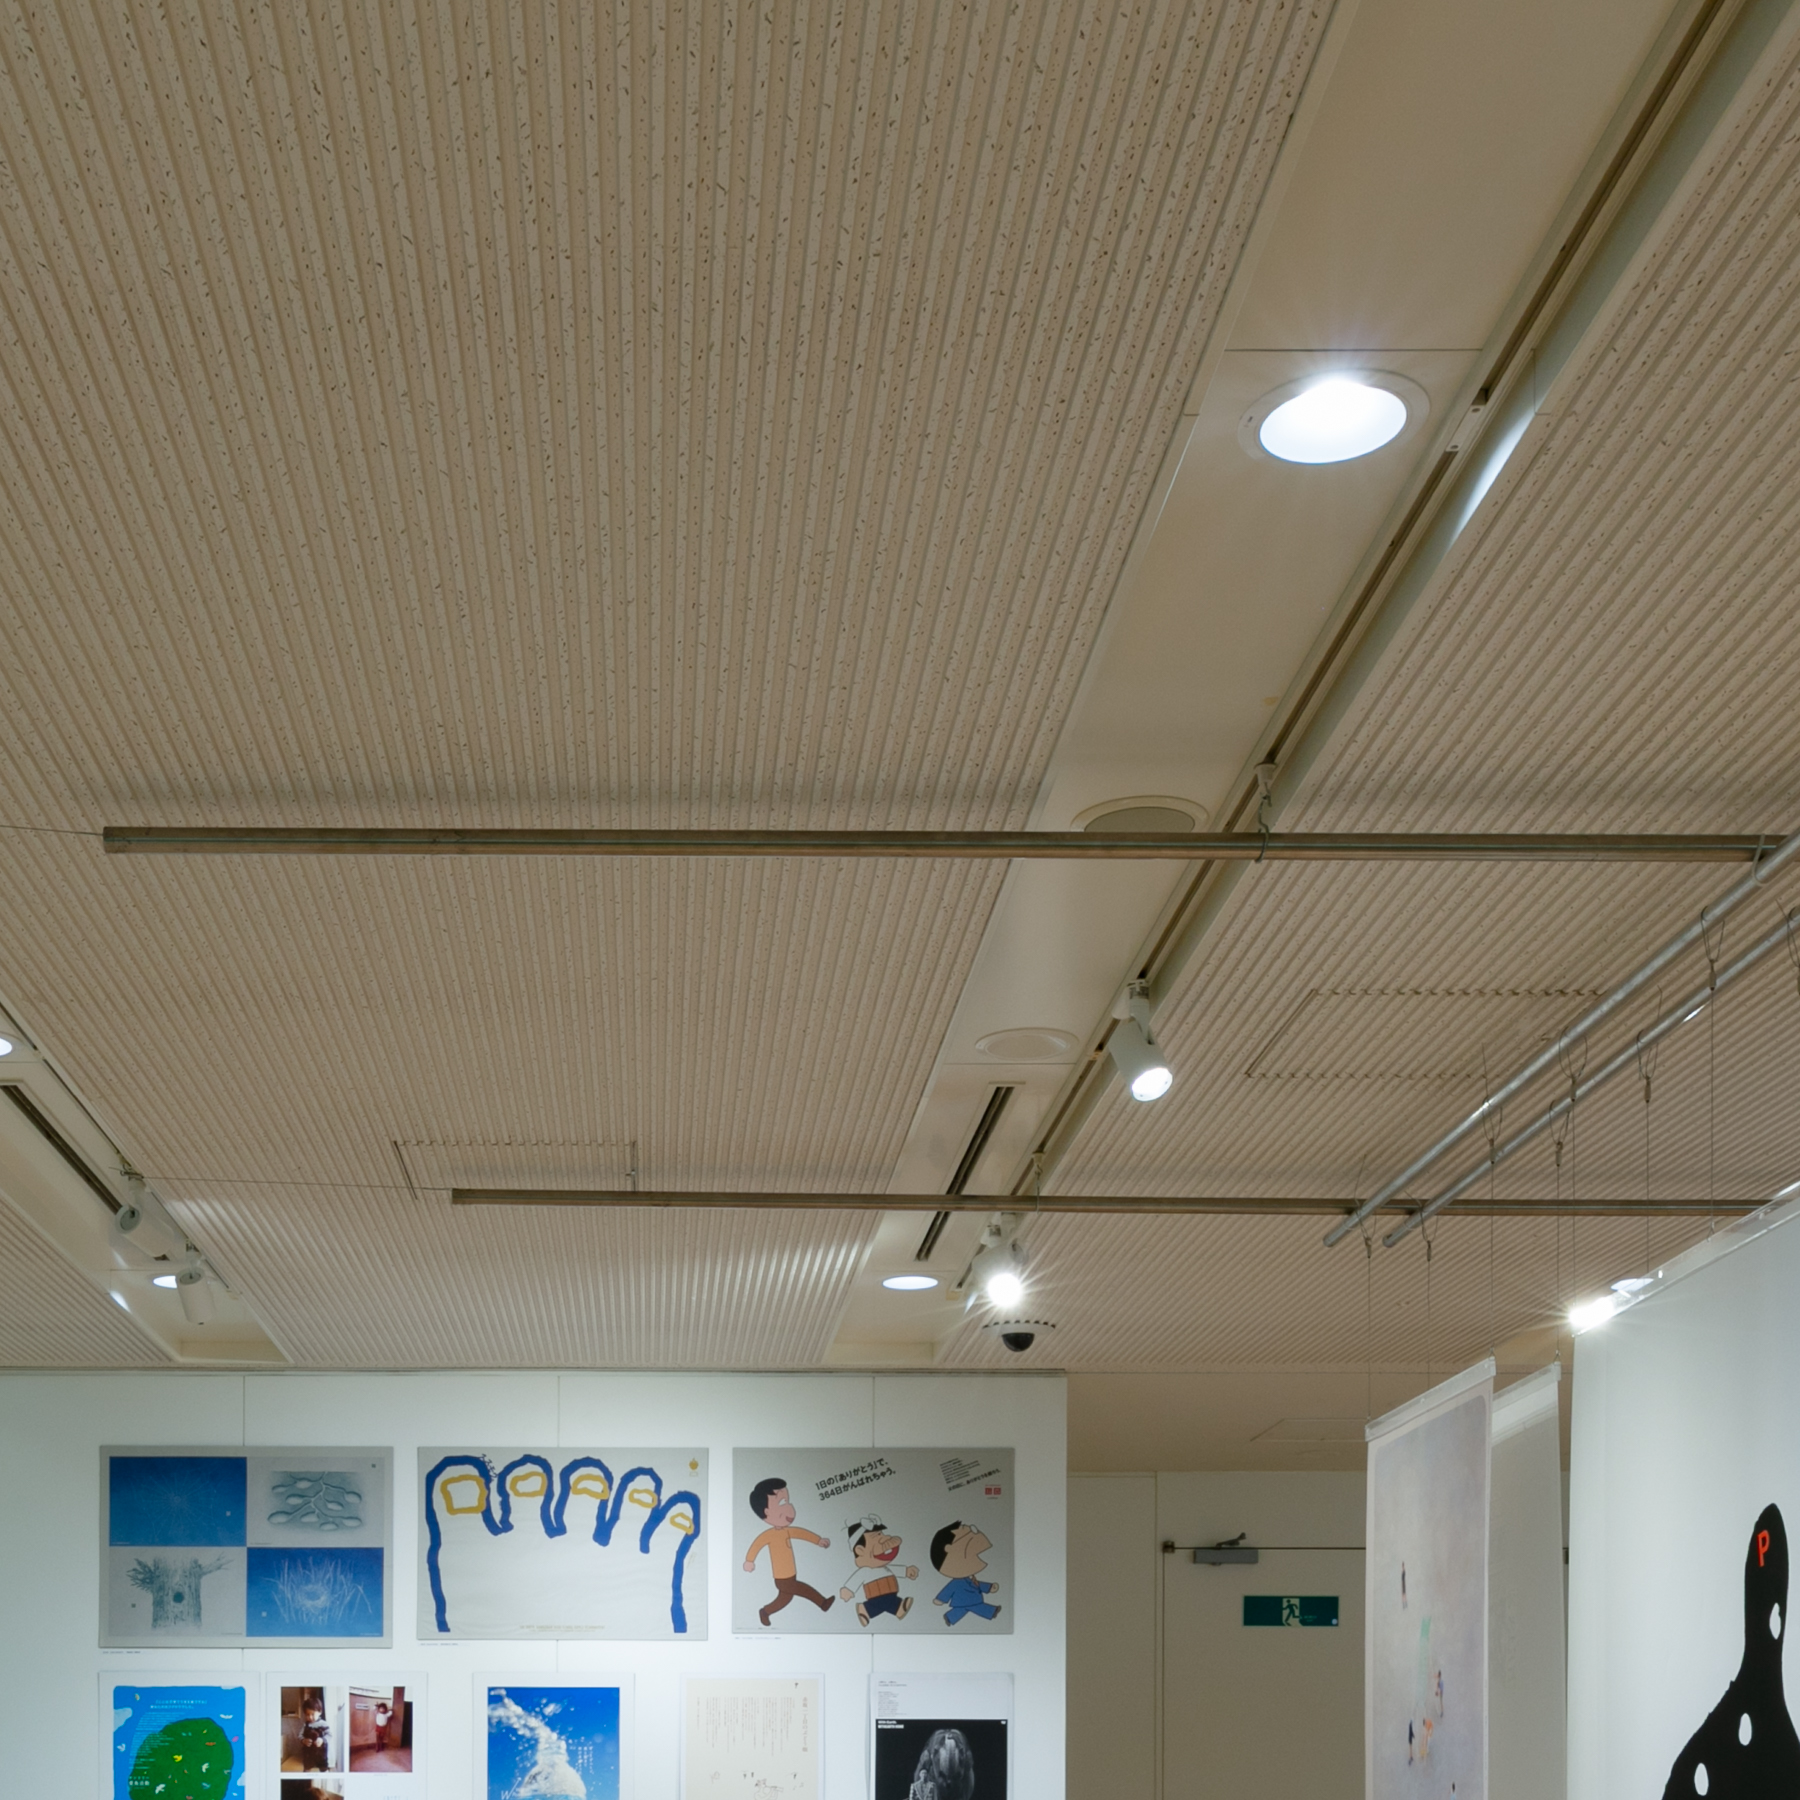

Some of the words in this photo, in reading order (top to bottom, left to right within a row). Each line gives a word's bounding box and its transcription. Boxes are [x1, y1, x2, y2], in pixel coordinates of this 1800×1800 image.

[815, 1457, 889, 1490] 1日の「ありがとう」で、
[818, 1467, 896, 1501] 364日がんばれちゃう。
[1757, 1529, 1770, 1567] P
